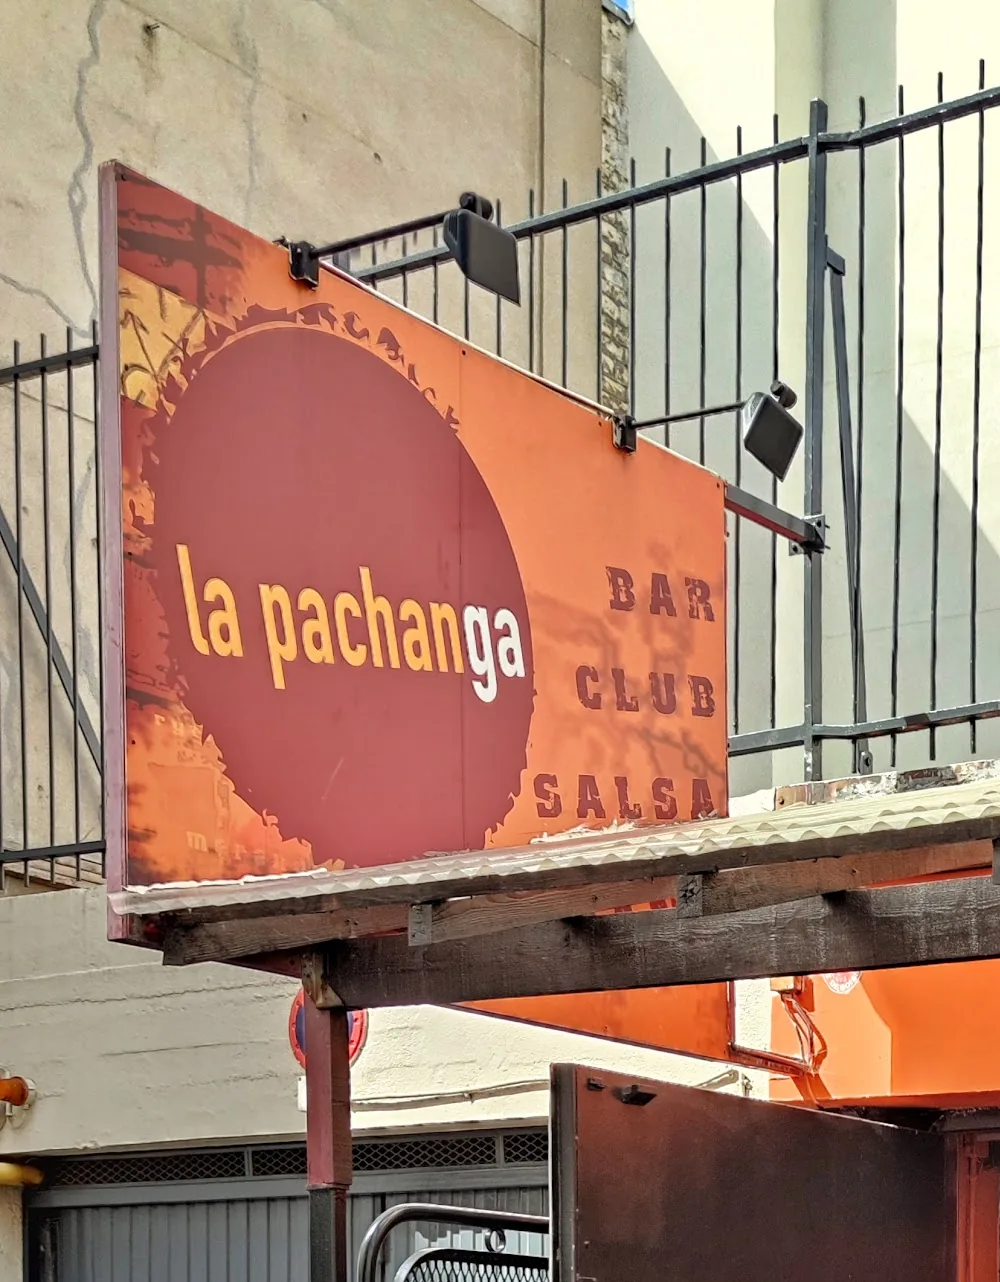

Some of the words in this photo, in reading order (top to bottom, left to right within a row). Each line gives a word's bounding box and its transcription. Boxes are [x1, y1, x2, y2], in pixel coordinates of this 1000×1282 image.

[606, 565, 716, 623] BAR
[175, 543, 244, 658] la
[257, 565, 527, 703] pachanga
[575, 665, 716, 719] CLUB
[534, 772, 716, 820] SALSA
